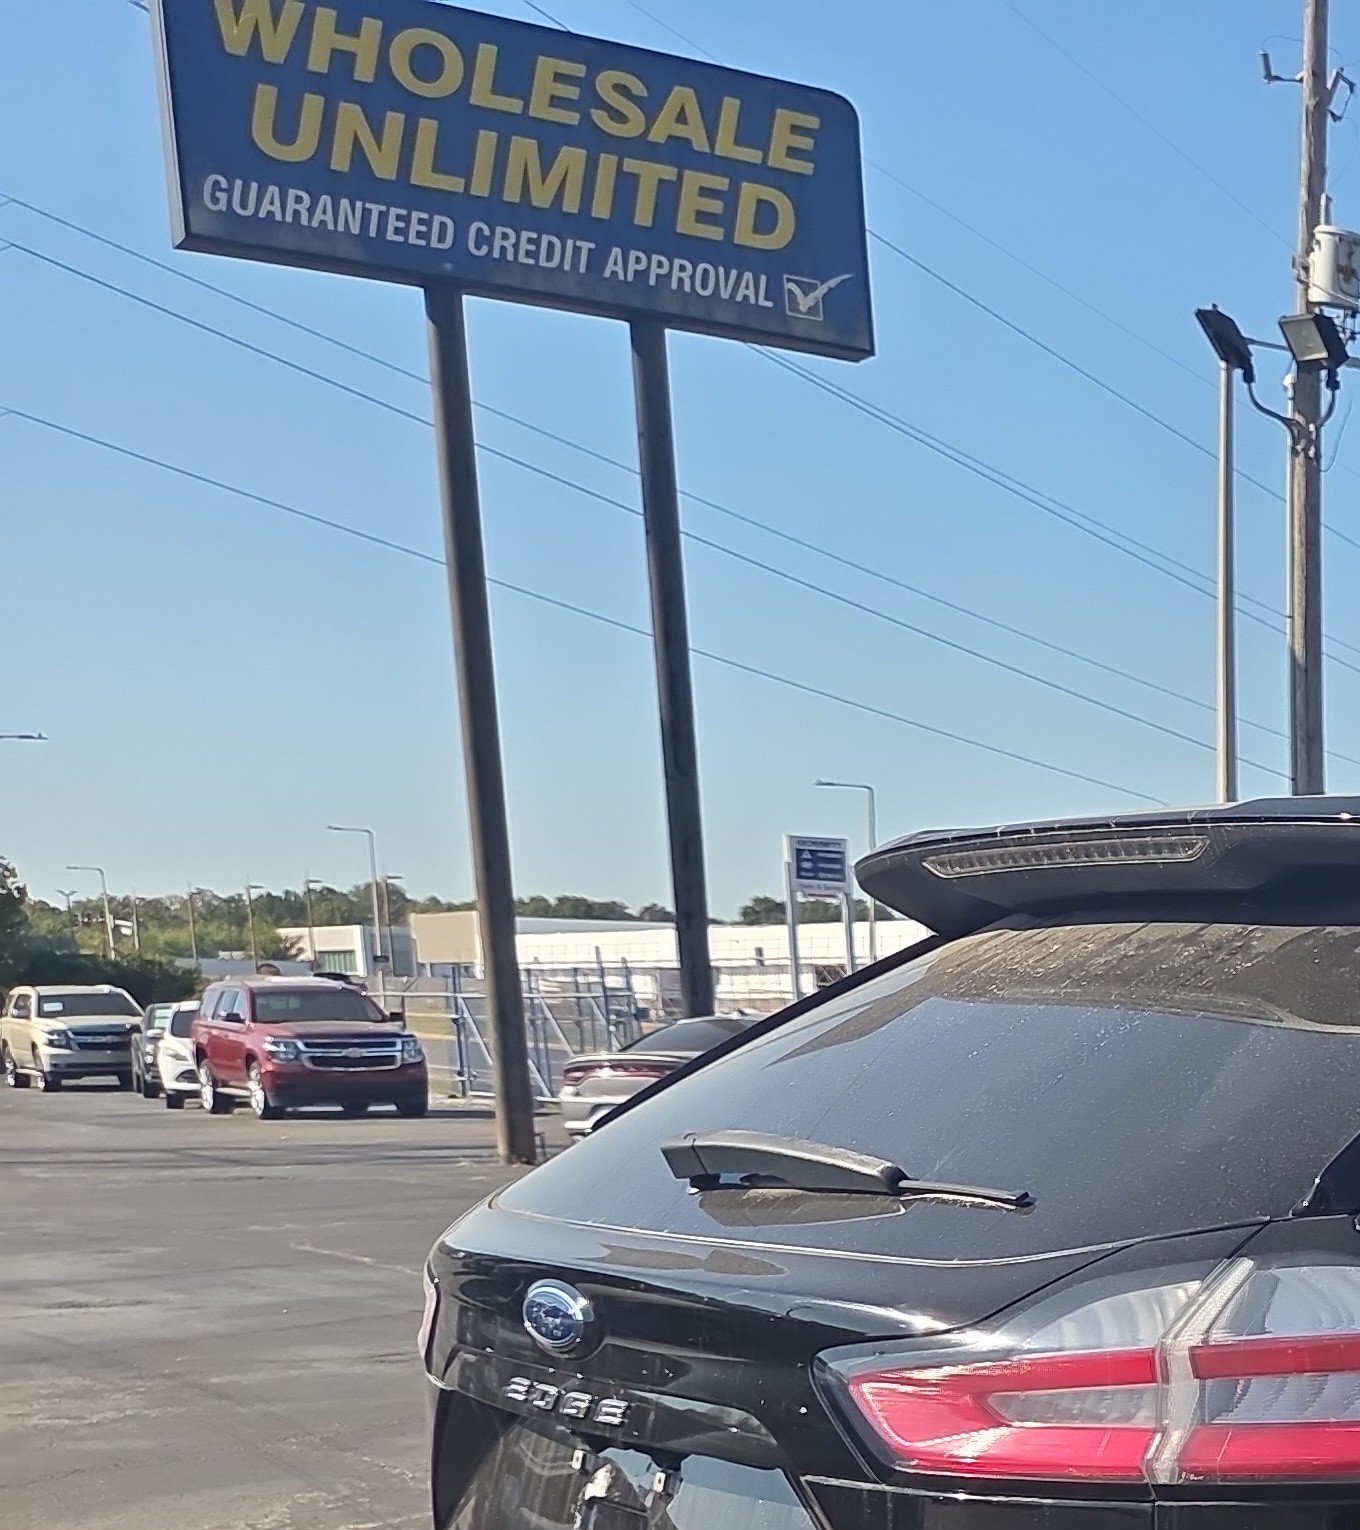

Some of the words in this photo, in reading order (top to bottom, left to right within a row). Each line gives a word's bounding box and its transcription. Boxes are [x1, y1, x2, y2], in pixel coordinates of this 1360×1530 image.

[211, 0, 821, 175] WHOLESALE
[202, 173, 455, 250] GUARANTEED
[467, 220, 597, 274] CREDIT
[603, 246, 774, 308] APPROVAL
[251, 83, 797, 252] UNLIMITED
[502, 1376, 629, 1426] EDGE
